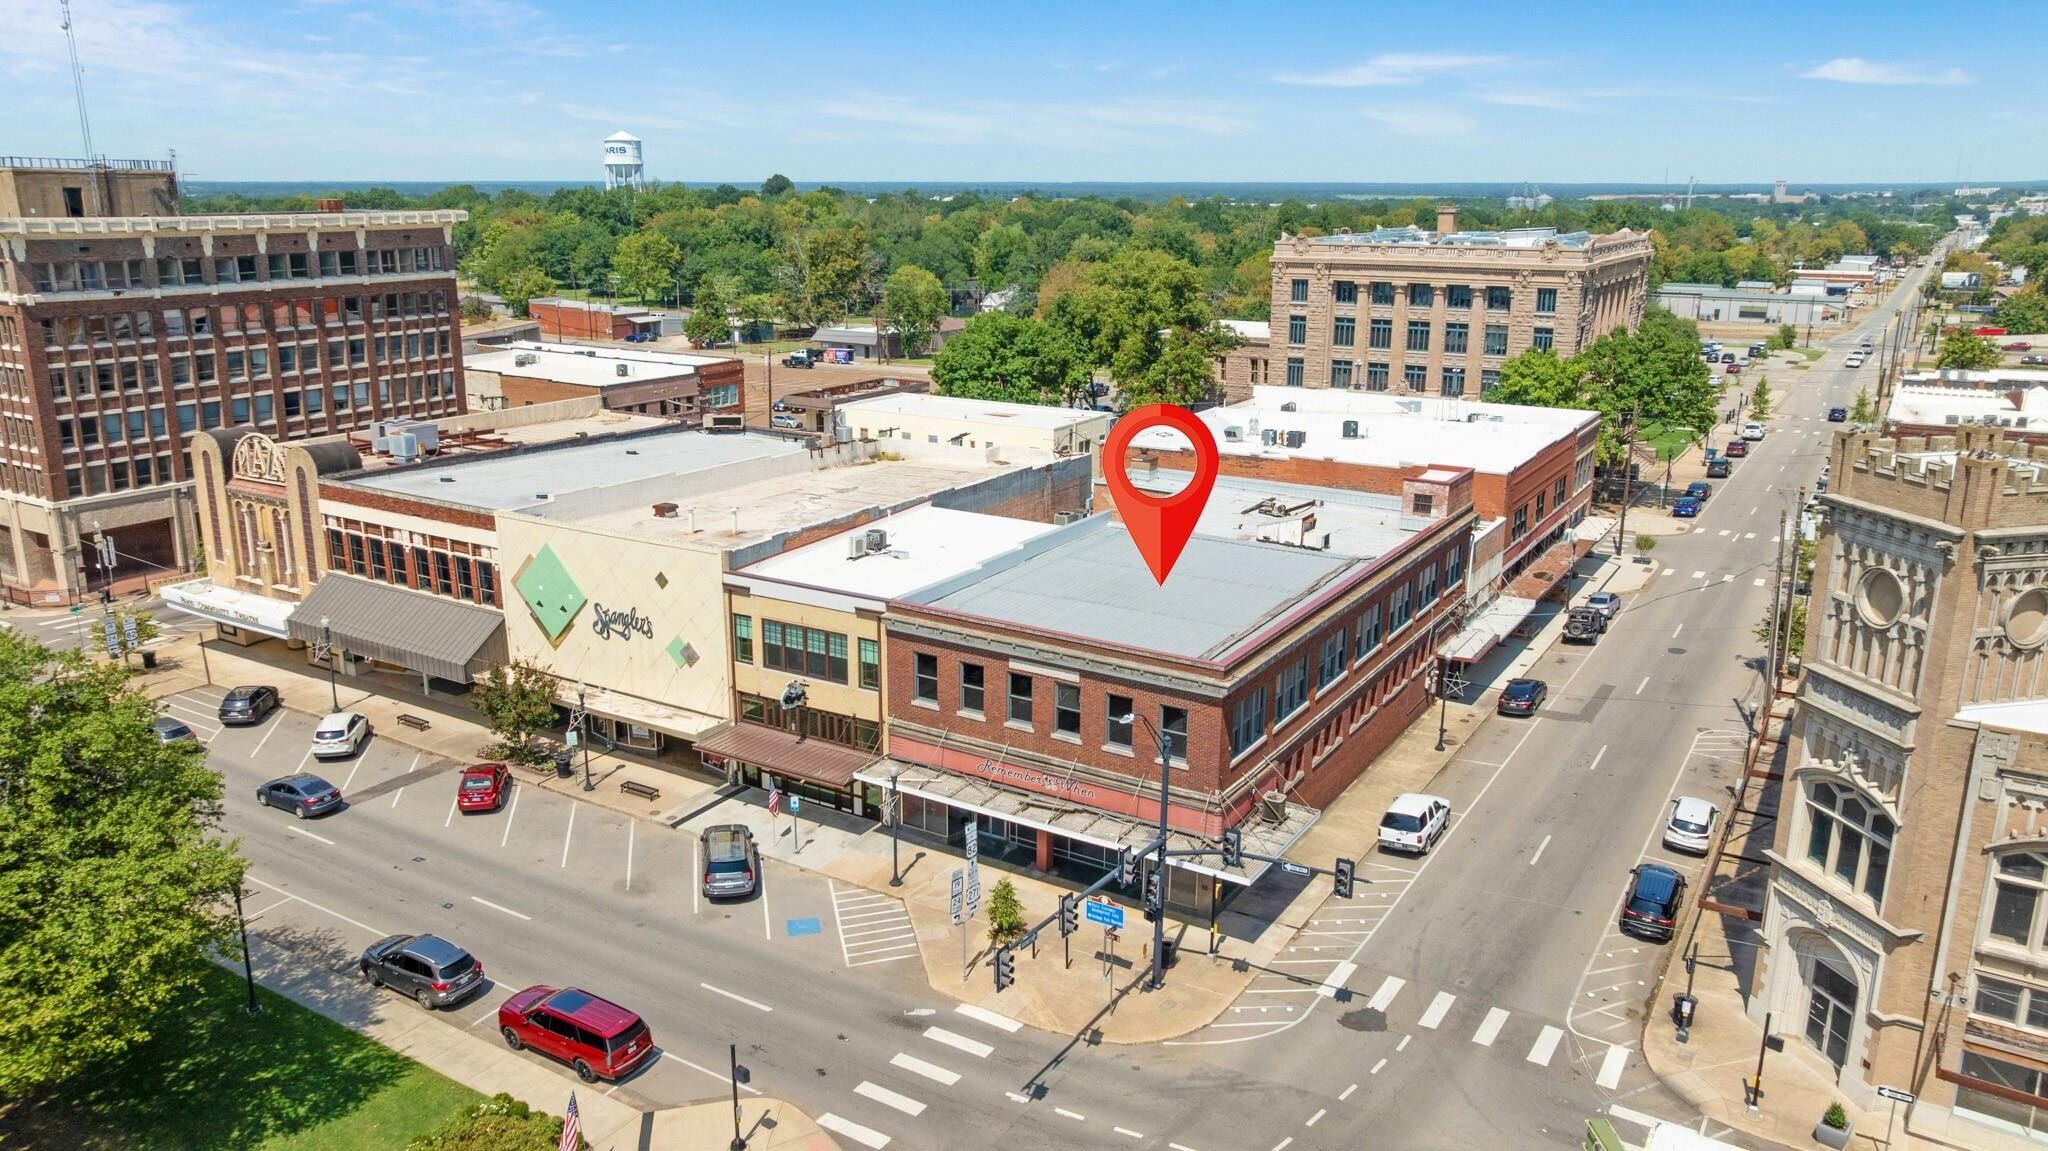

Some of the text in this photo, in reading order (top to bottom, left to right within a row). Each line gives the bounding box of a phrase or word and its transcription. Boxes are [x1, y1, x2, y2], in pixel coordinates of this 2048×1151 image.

[238, 437, 286, 483] PLAZA
[592, 602, 653, 641] Spangler's
[126, 630, 136, 639] 82
[976, 759, 1095, 800] Remember When
[967, 843, 977, 856] 82
[954, 880, 960, 889] 19
[968, 887, 979, 900] 271
[953, 897, 961, 906] 24
